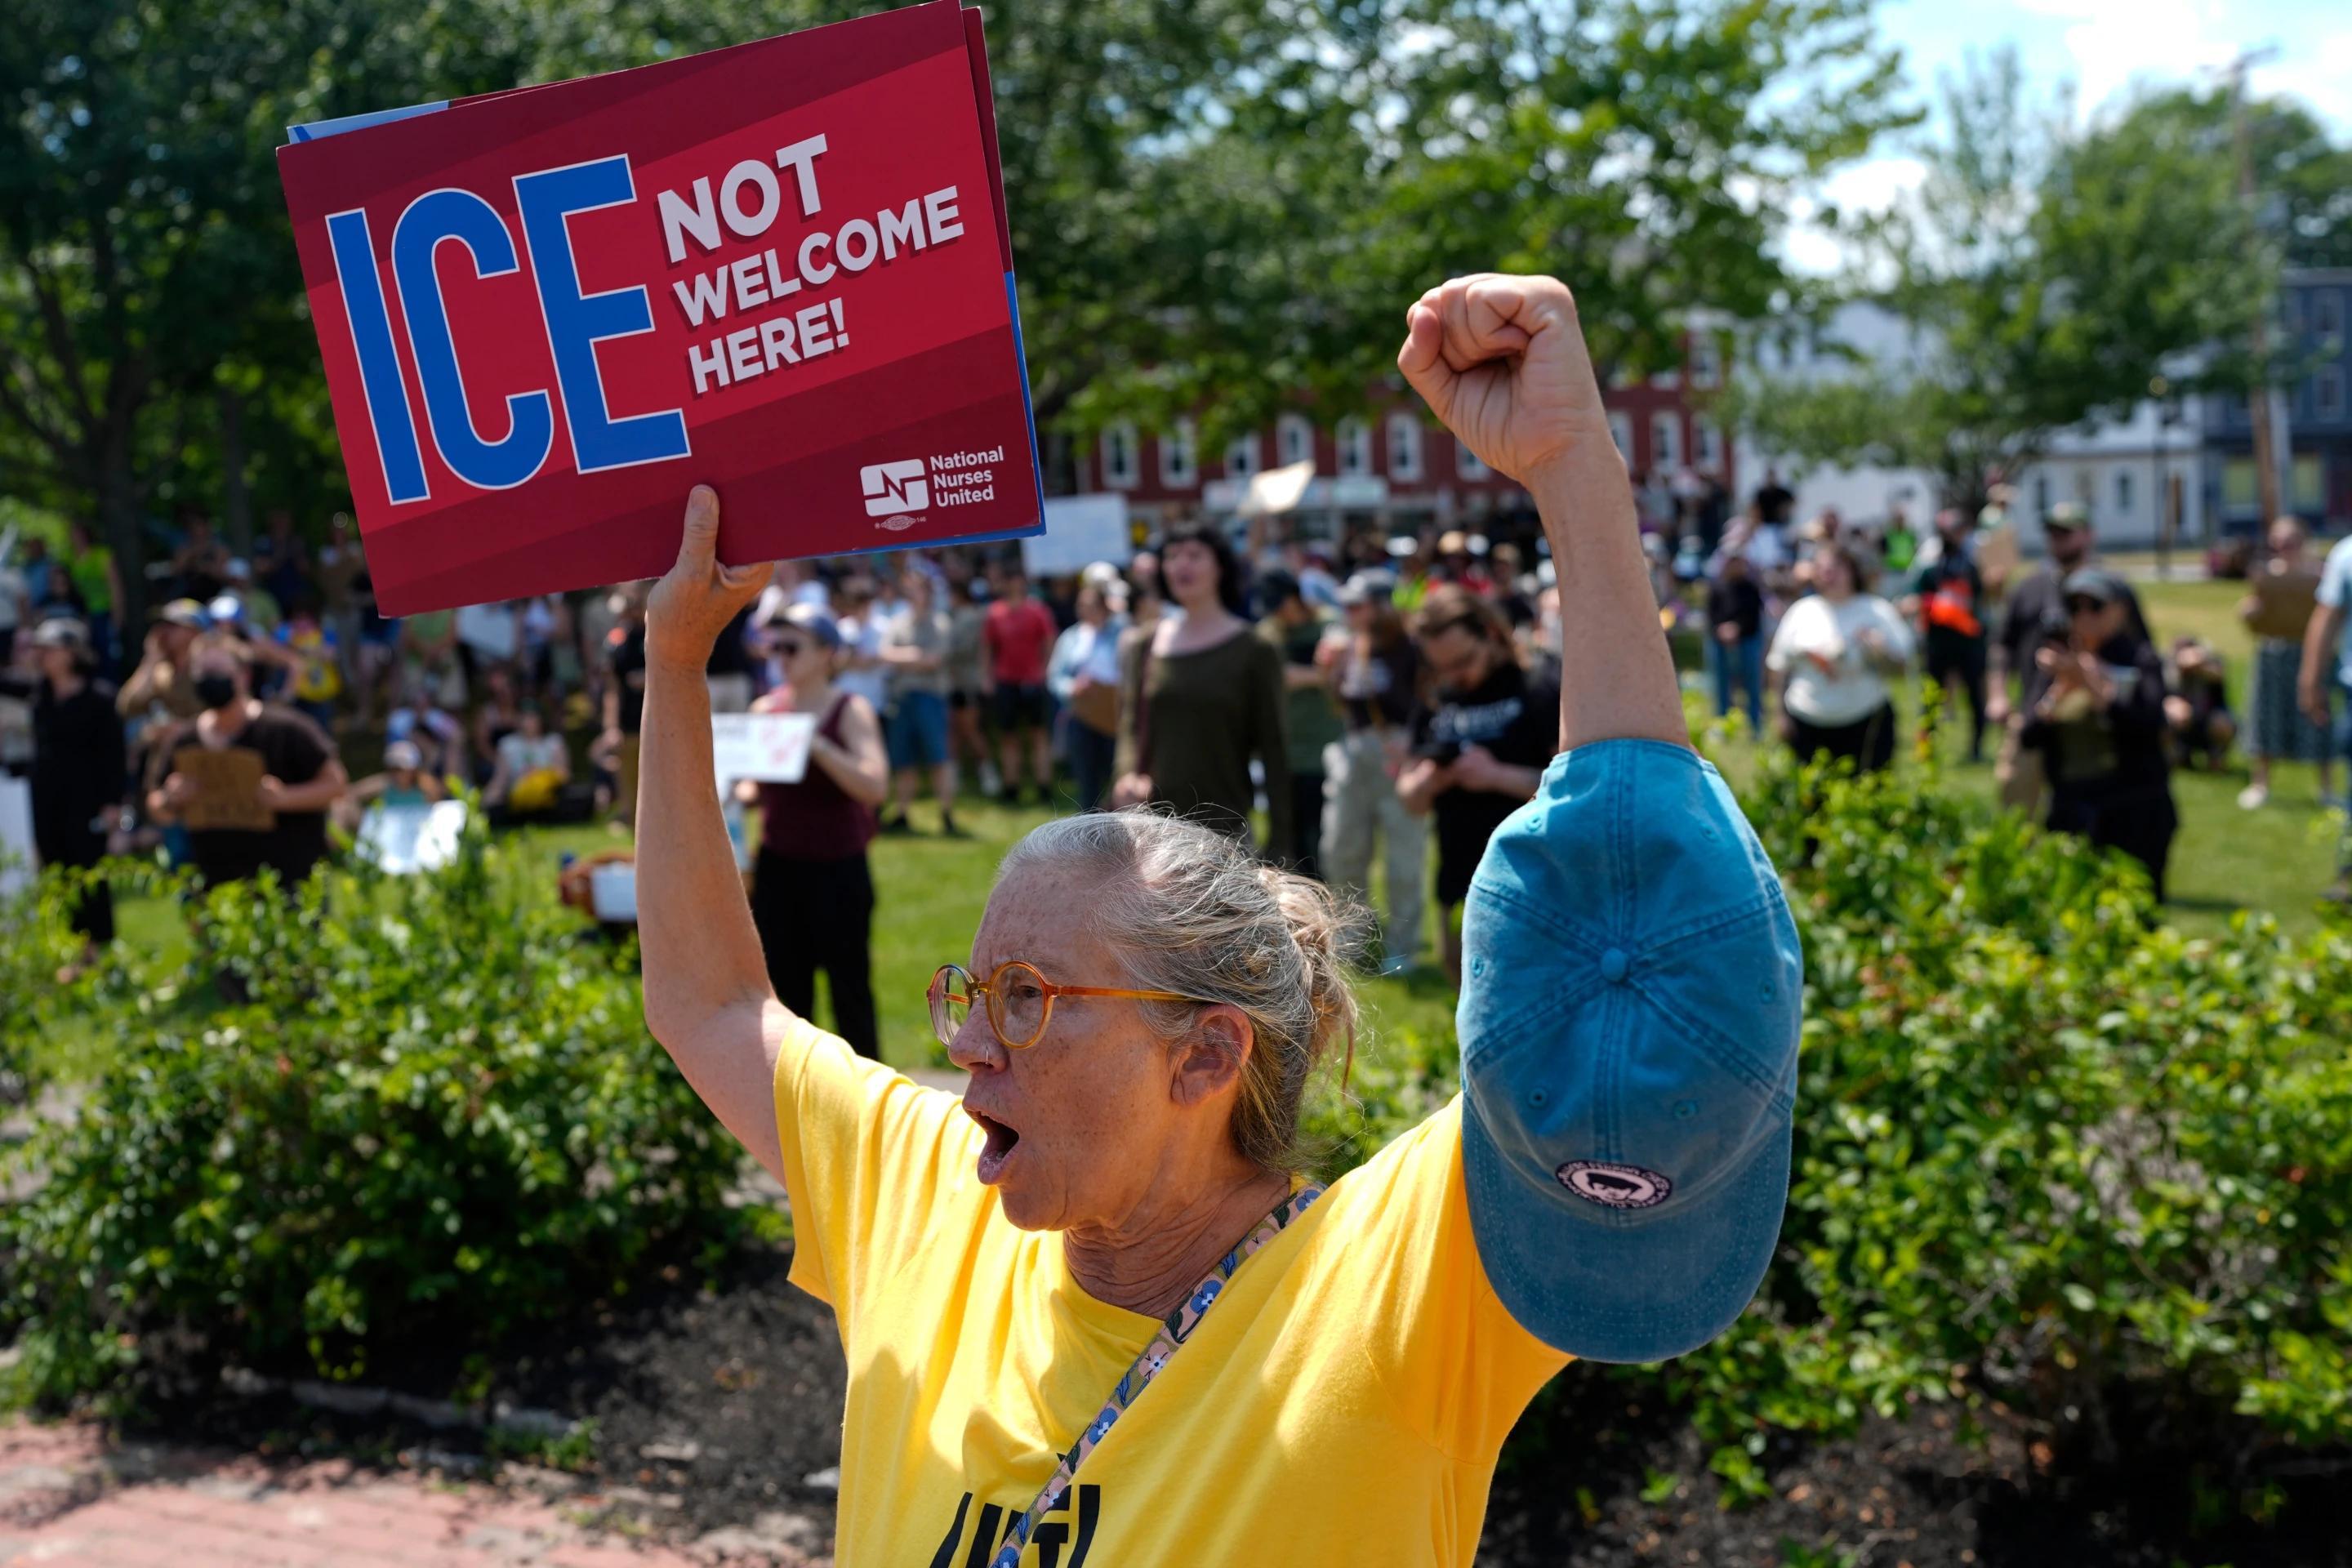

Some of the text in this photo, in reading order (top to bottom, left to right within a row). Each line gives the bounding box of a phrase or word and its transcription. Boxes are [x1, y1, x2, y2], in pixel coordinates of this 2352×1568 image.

[657, 133, 828, 263] NOT
[672, 185, 964, 327] WELCOME
[325, 154, 692, 506] ICE
[688, 297, 850, 394] HERE!
[929, 445, 1004, 471] National
[933, 470, 993, 489] Nurses
[935, 484, 994, 507] United
